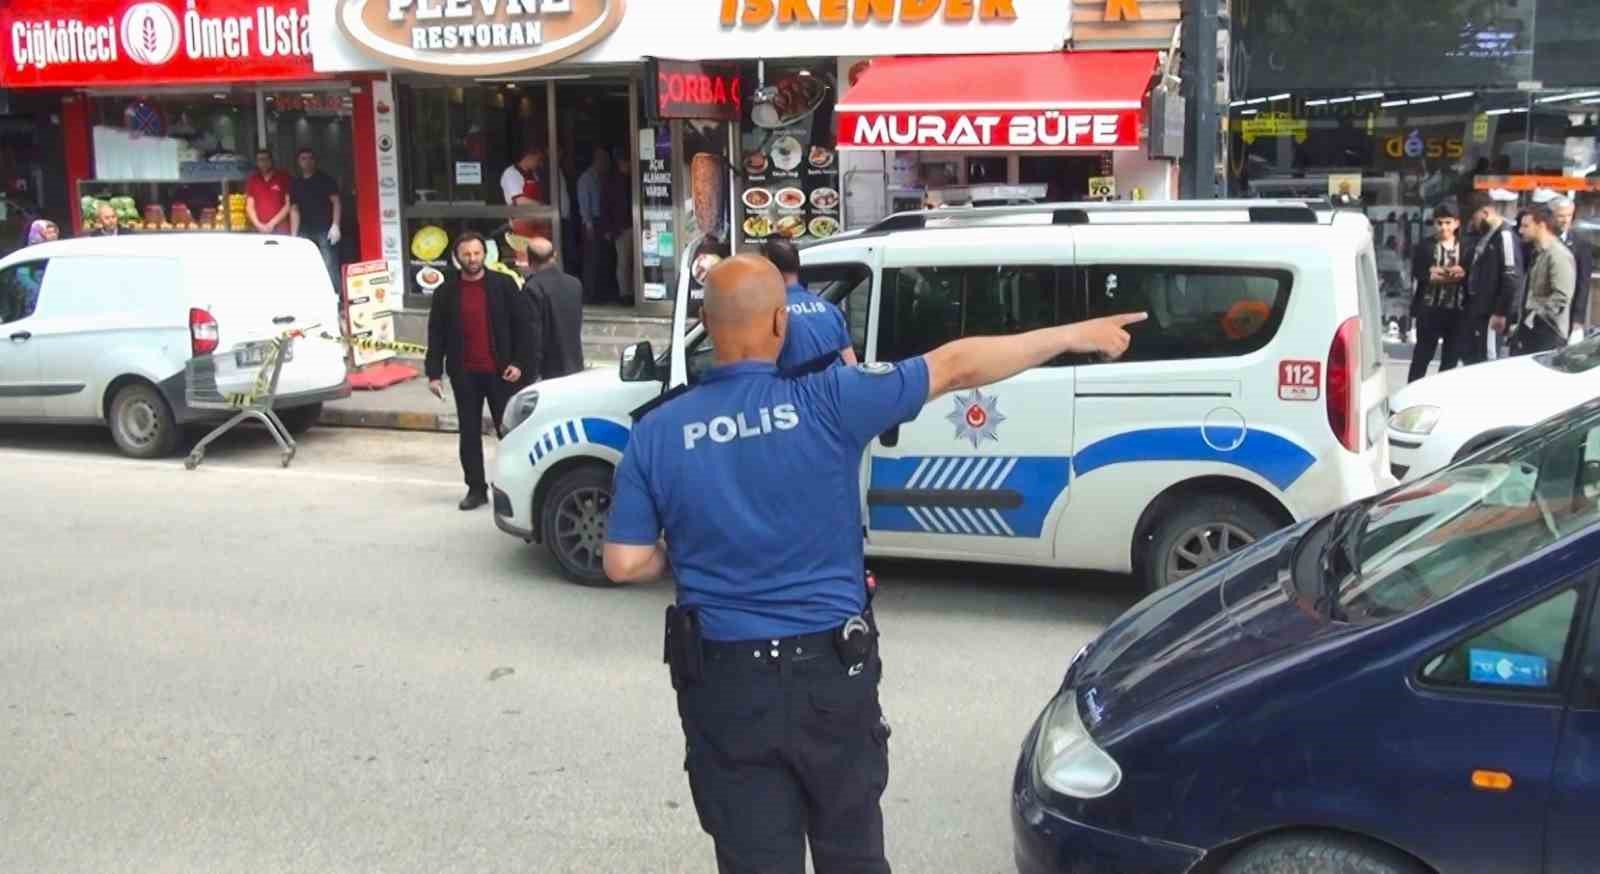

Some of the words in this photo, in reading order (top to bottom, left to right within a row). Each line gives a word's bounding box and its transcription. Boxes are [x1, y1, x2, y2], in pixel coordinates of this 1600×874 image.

[11, 17, 118, 71] Çiğköfteci
[184, 0, 252, 59] Ömer
[257, 7, 313, 57] Usta
[412, 21, 542, 50] RESTORAN
[853, 114, 1001, 145] MURAT
[1008, 110, 1119, 145] BÜFE
[1284, 364, 1315, 385] 112
